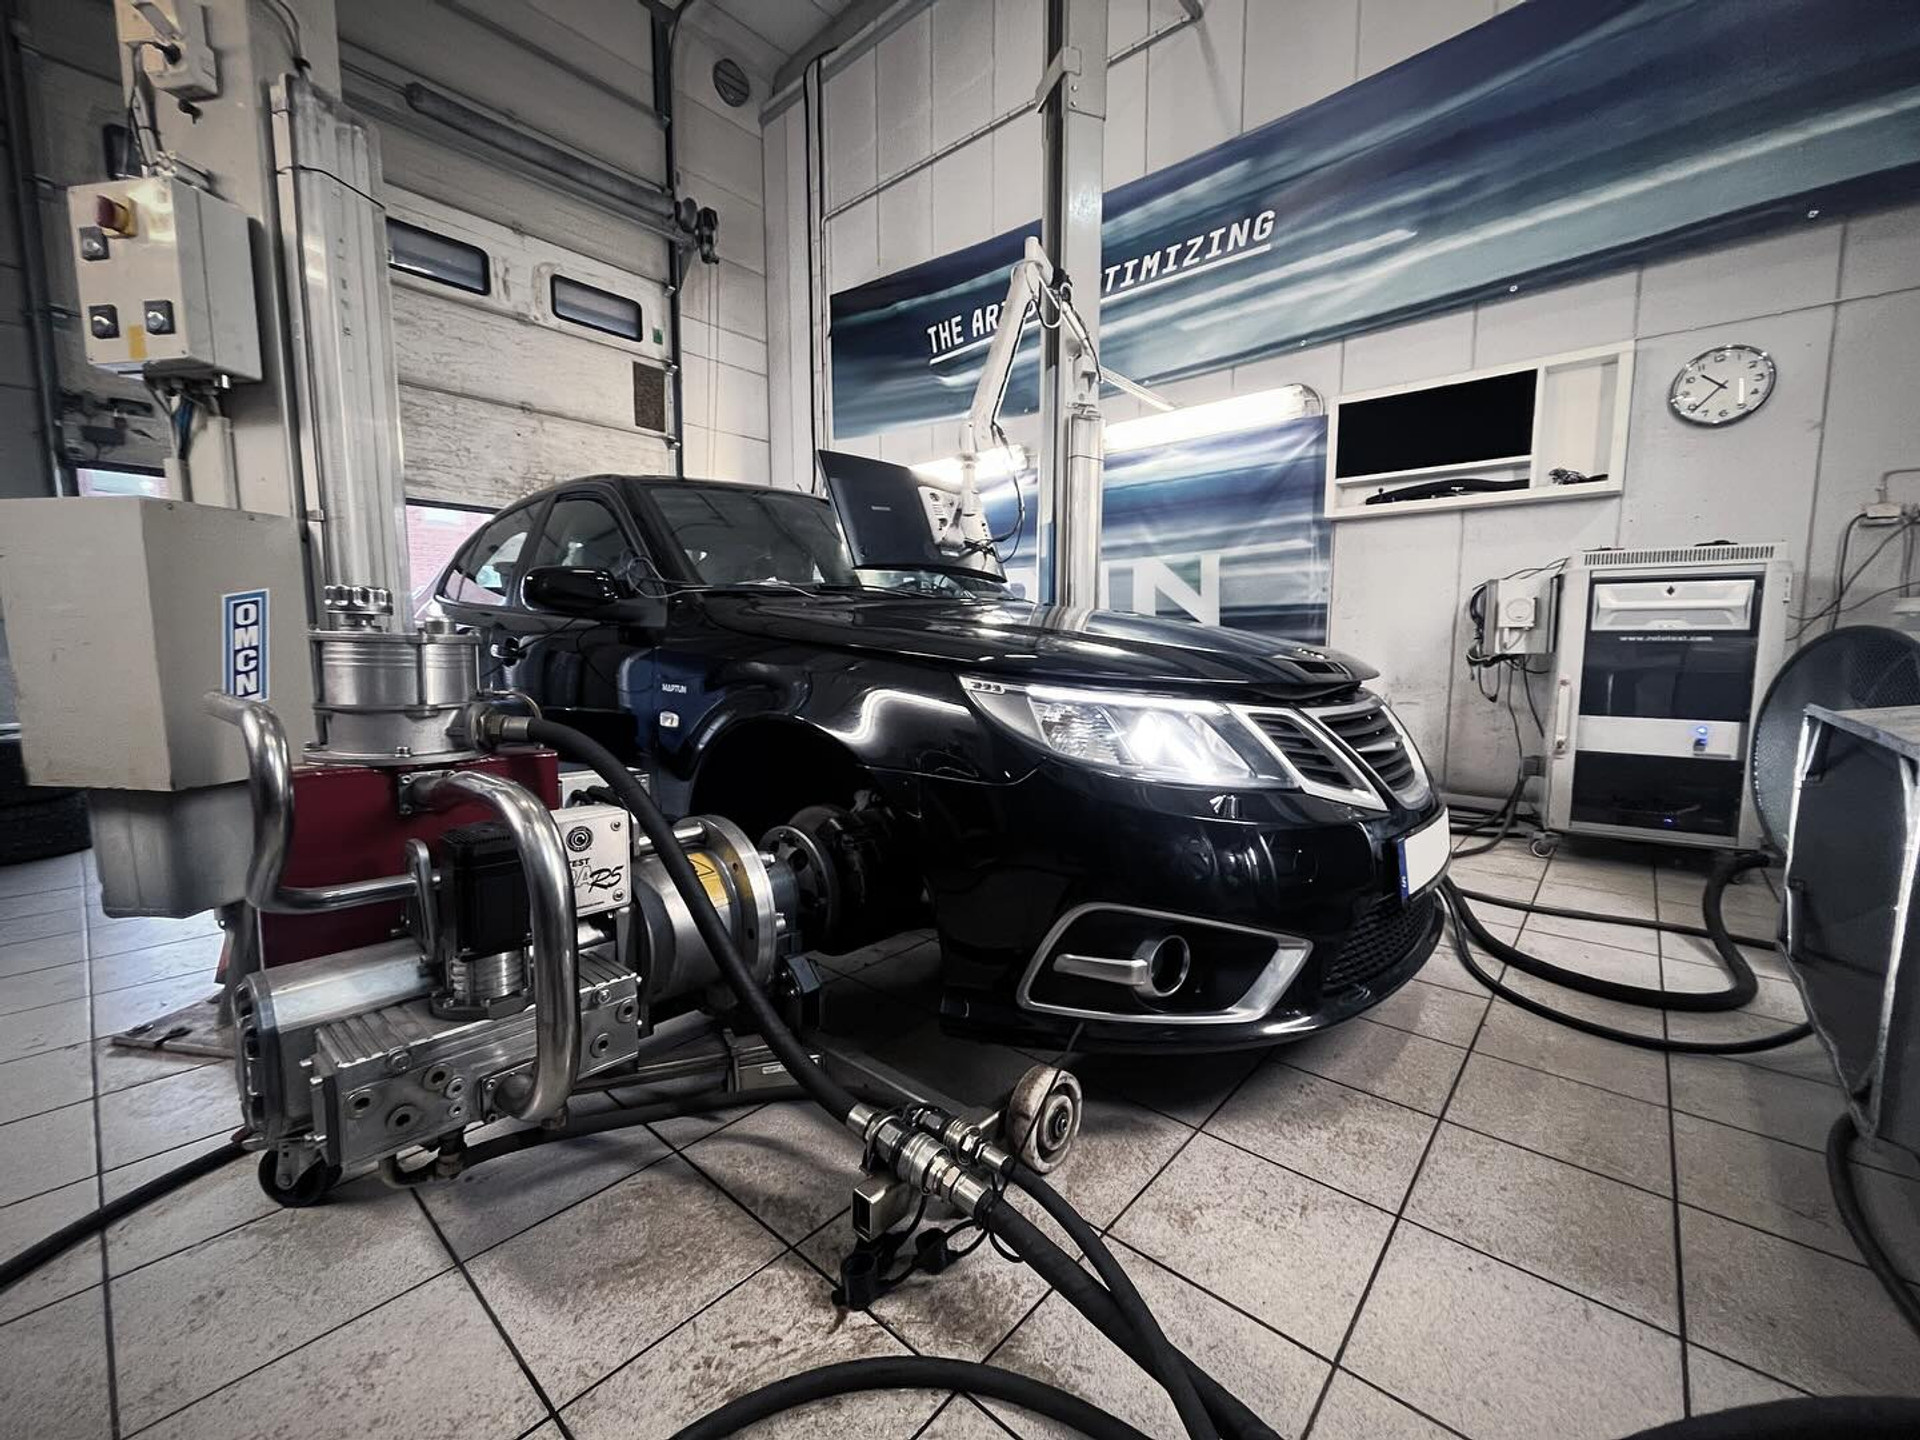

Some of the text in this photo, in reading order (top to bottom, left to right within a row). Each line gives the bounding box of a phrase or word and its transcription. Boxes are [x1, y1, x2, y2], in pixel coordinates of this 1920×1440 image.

[927, 315, 964, 354] THE
[972, 301, 1007, 338] AR
[1104, 210, 1276, 293] TIMIZING
[234, 602, 260, 696] OMCN
